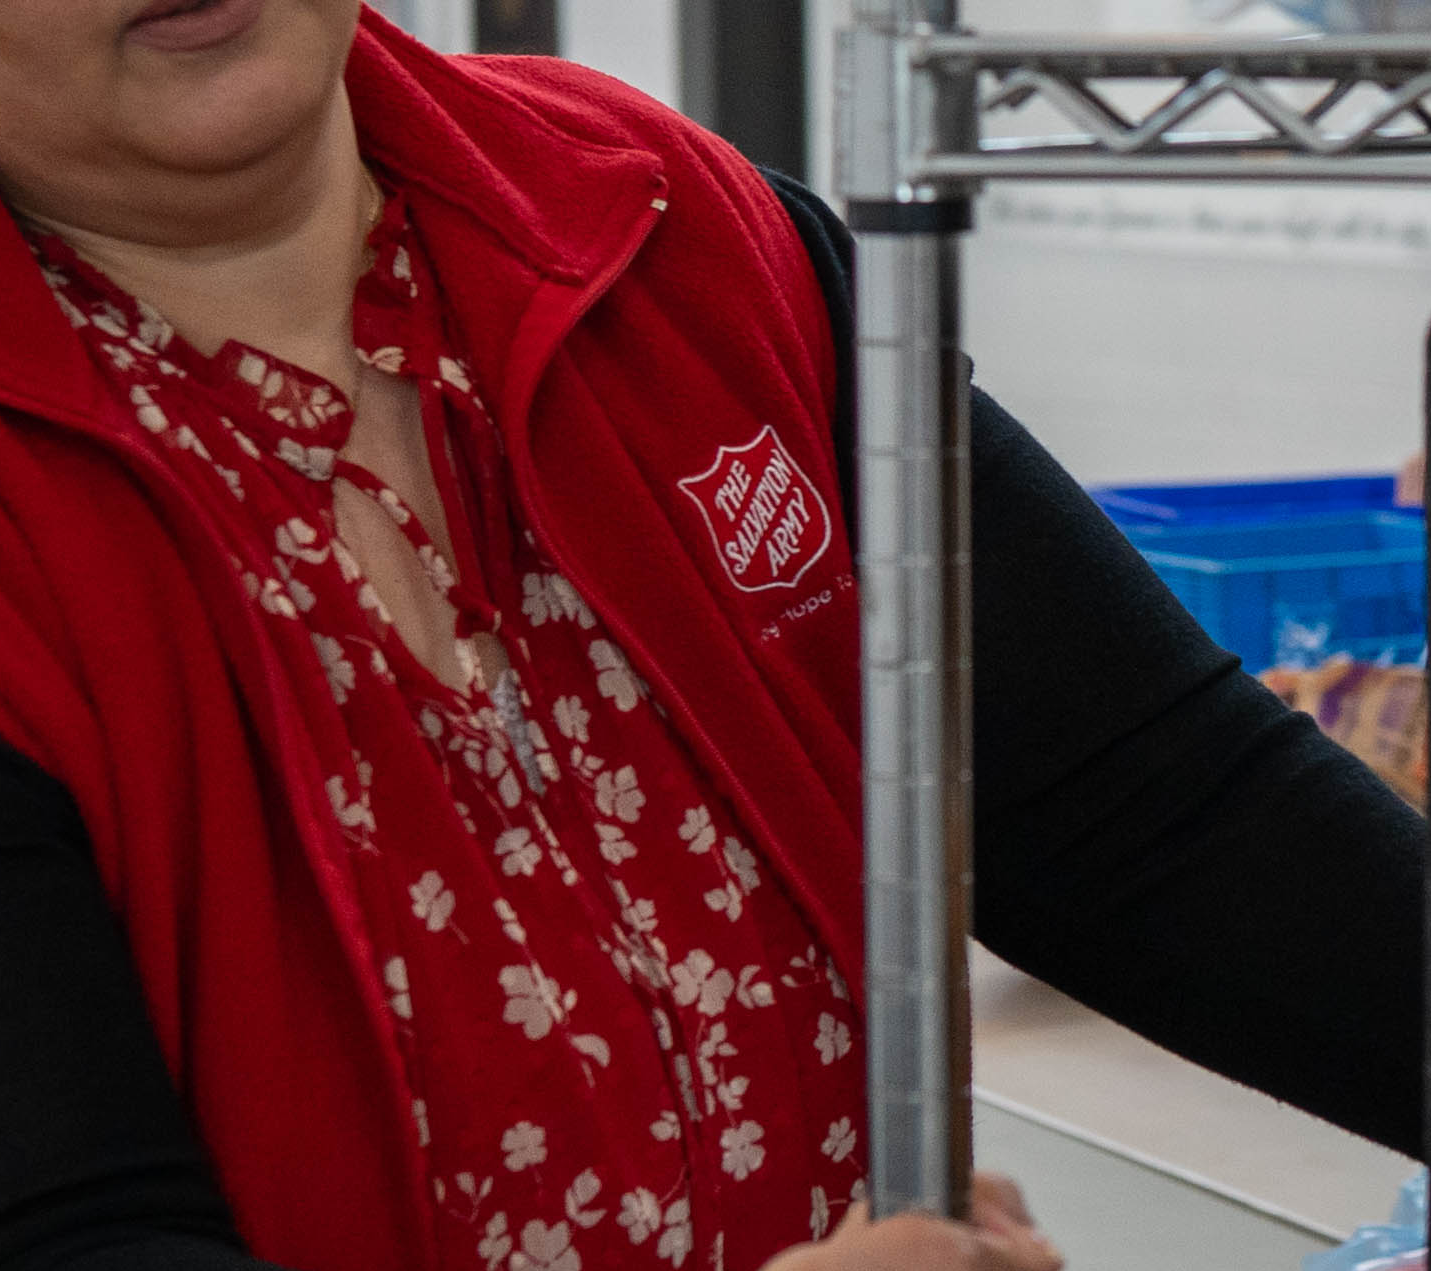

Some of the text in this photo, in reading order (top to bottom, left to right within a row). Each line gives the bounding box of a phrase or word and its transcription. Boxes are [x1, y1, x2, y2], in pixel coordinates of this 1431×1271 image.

[715, 460, 752, 522] THE
[725, 448, 793, 575] SALVATION
[764, 486, 811, 578] ARMY
